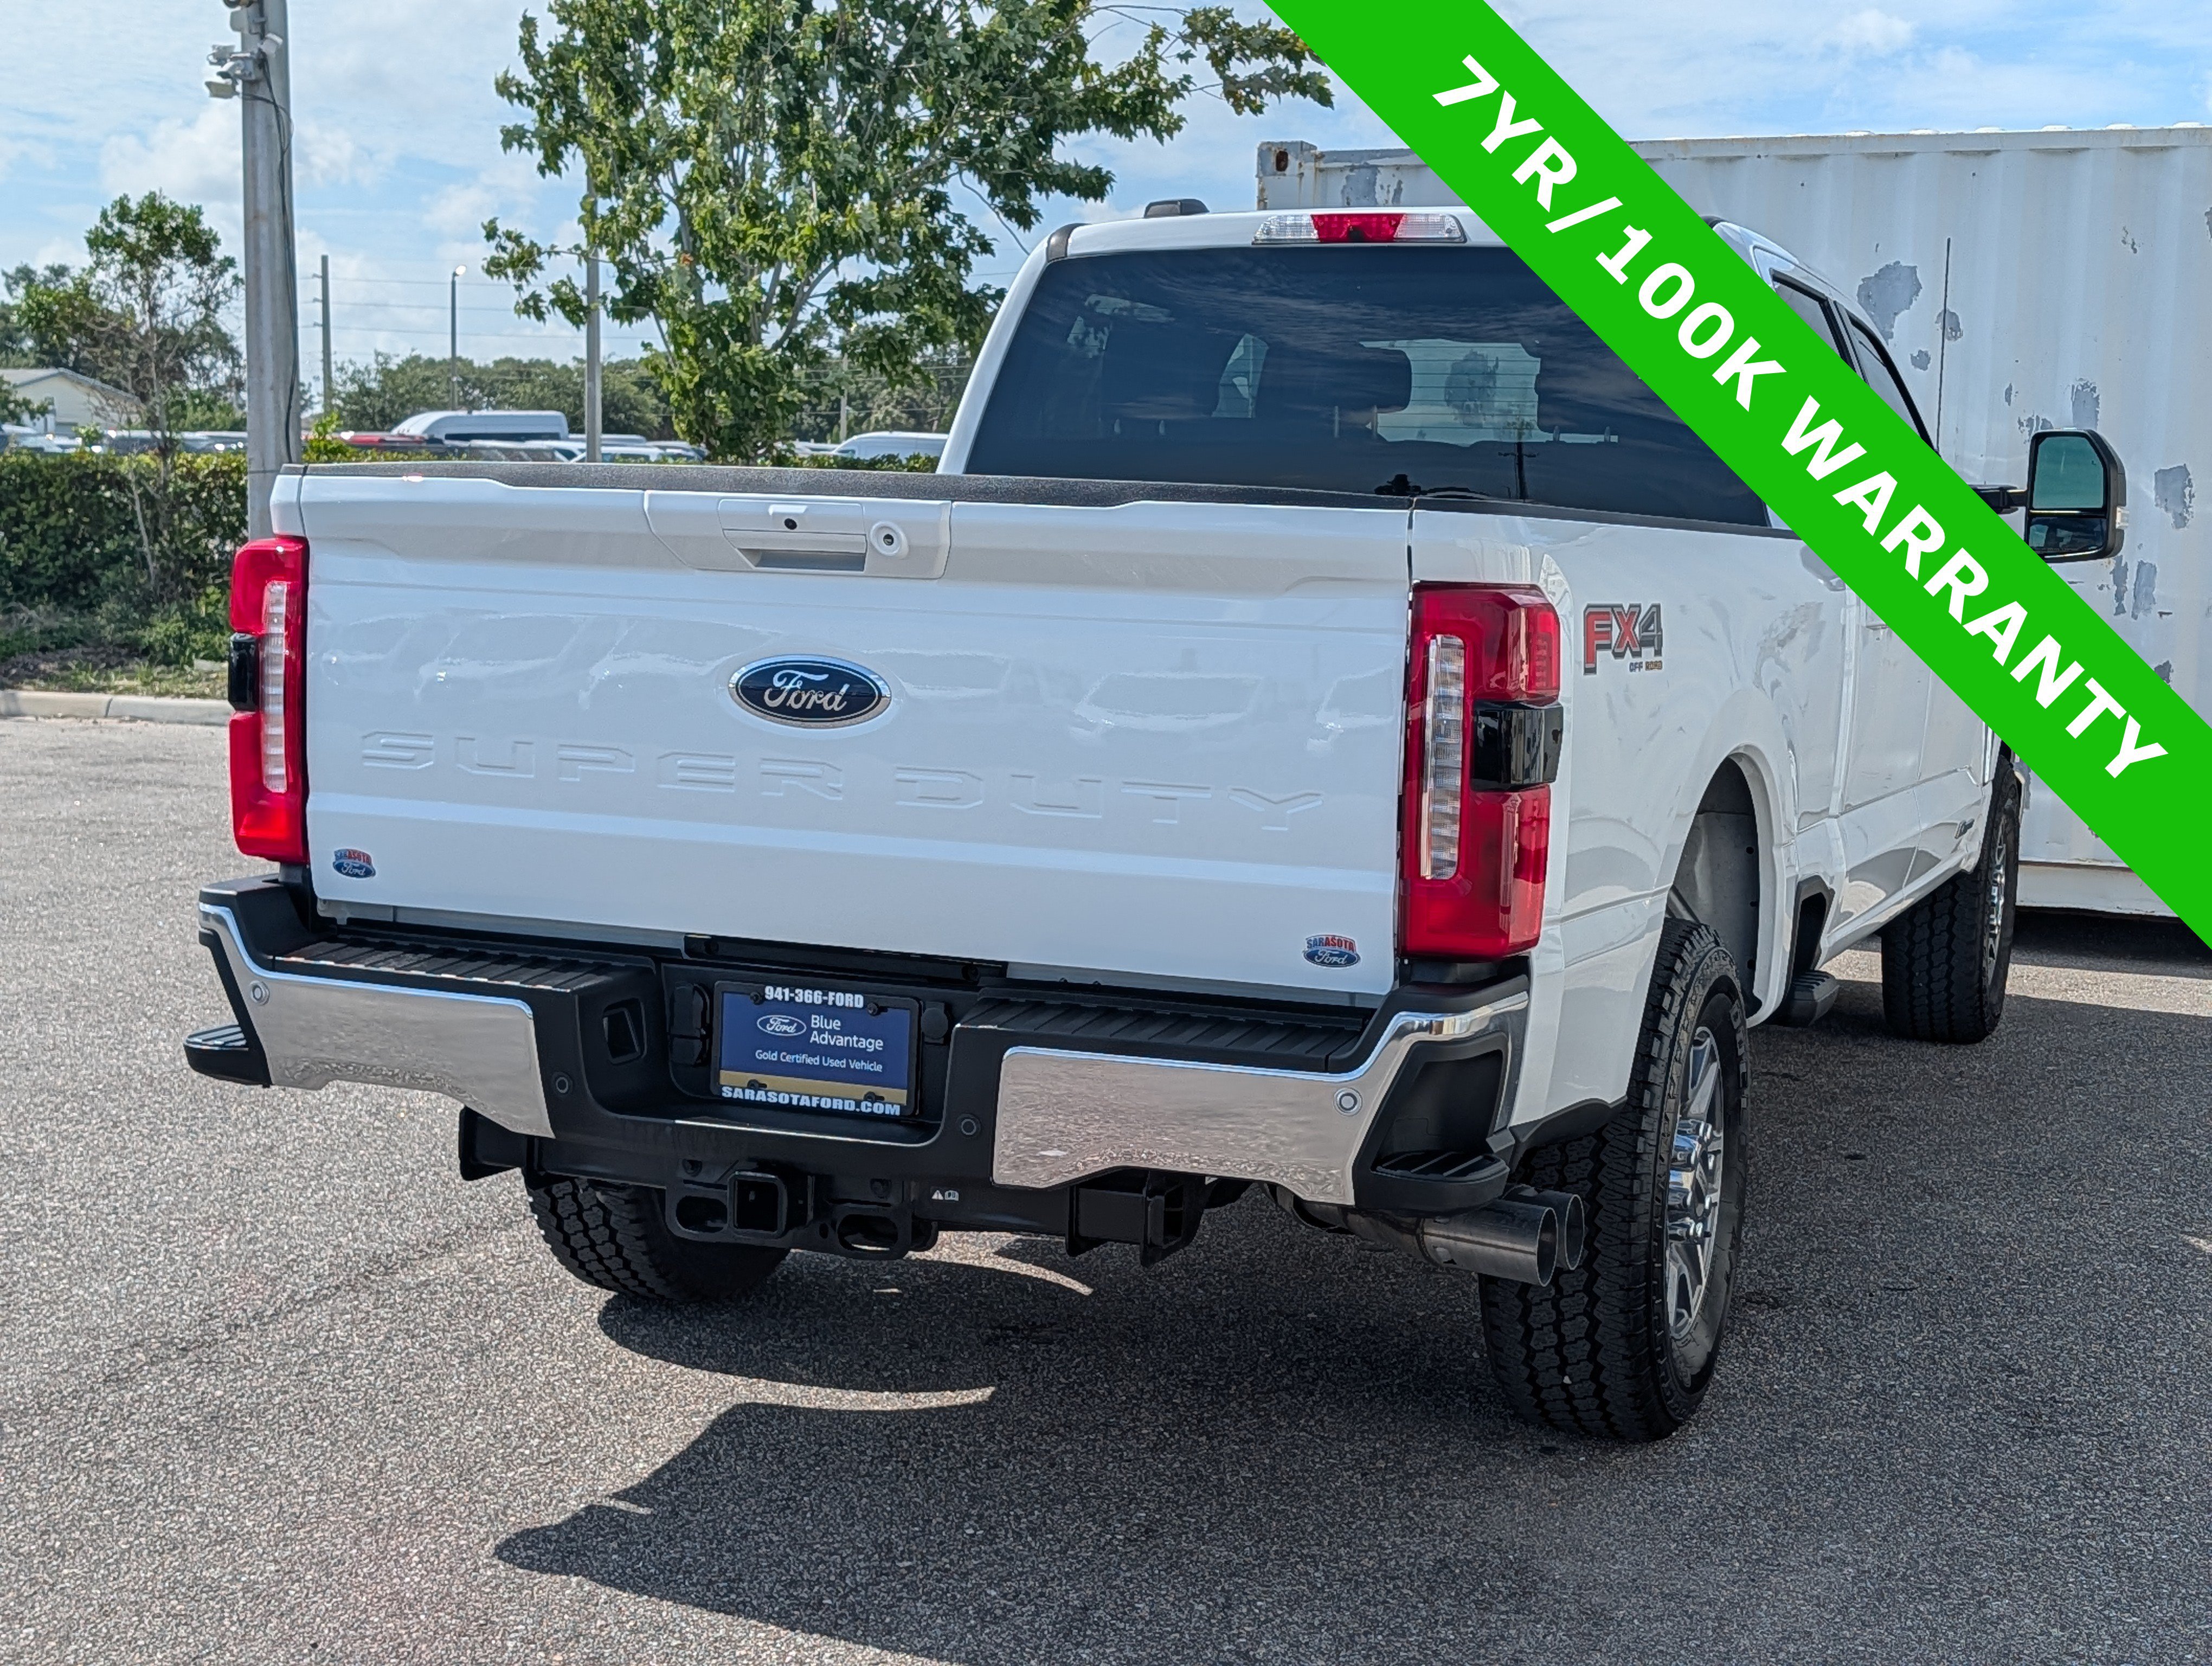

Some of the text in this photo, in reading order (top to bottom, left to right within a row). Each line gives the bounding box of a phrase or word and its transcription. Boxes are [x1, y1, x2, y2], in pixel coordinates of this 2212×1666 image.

[1583, 603, 1663, 676] FX4
[1629, 661, 1643, 672] OFF
[763, 669, 851, 711] Ford
[361, 731, 1324, 831] SUPER DUTY
[1306, 937, 1354, 953] SARASOTA
[1315, 950, 1348, 964] Ford
[764, 985, 864, 1008] 941-366-FORD
[766, 1016, 797, 1033] Ford
[811, 1014, 841, 1030] Blue
[809, 1031, 884, 1052] Advantage
[755, 1049, 883, 1072] Gold Certified Used Vehicle
[721, 1086, 901, 1116] SARASOTAFORD.COM
